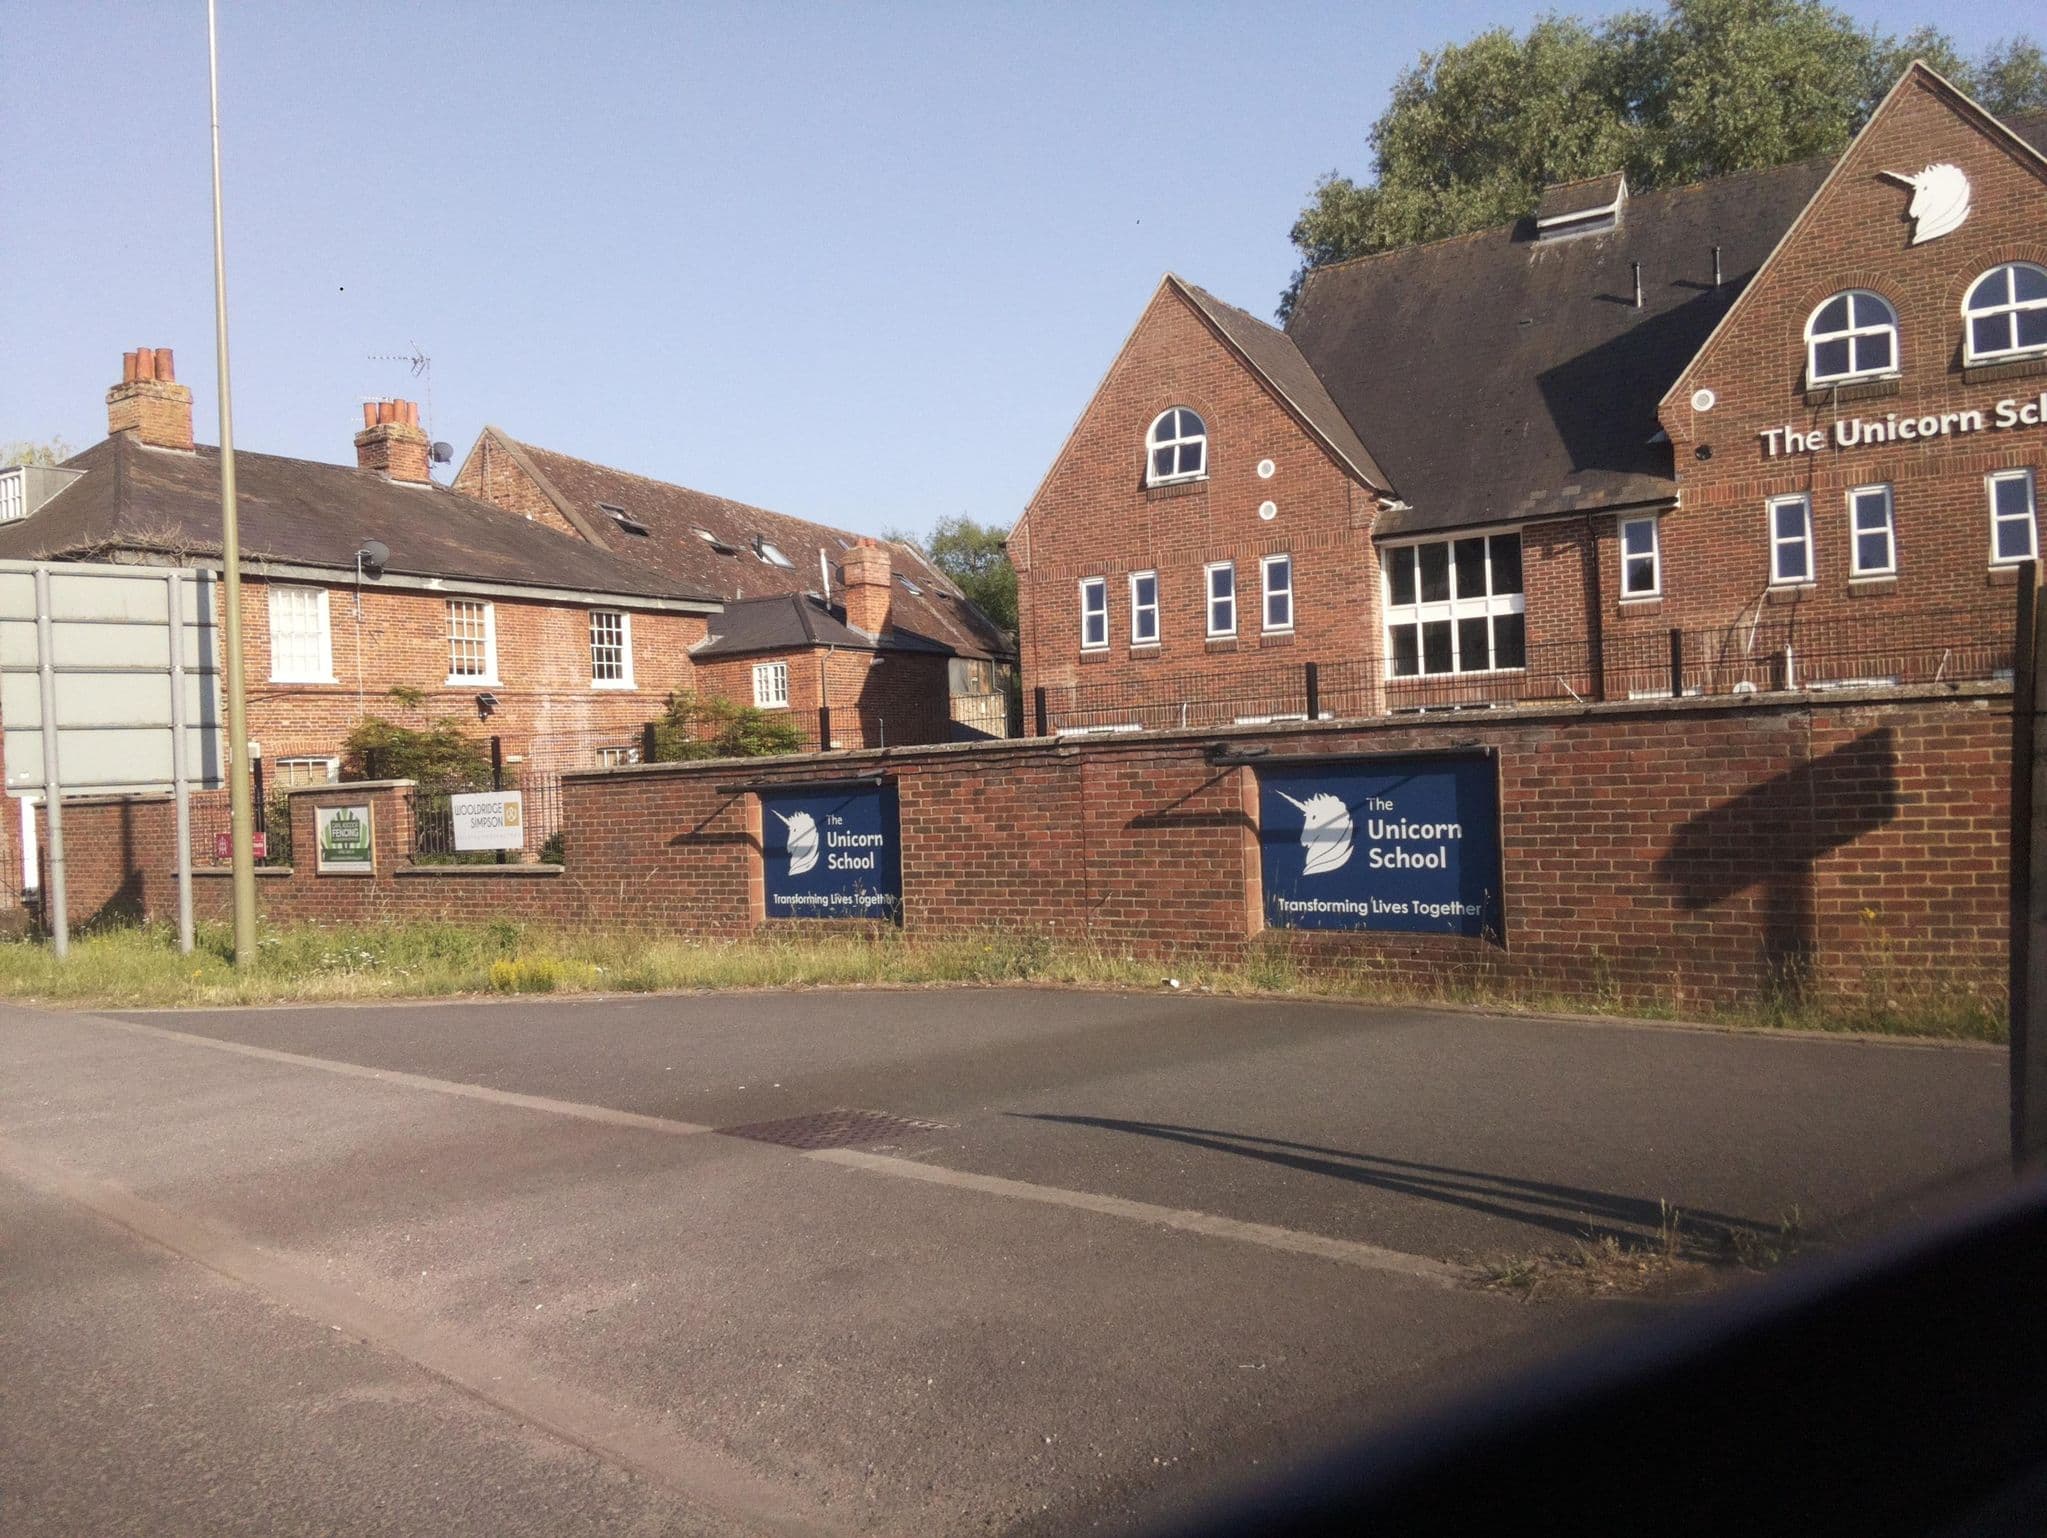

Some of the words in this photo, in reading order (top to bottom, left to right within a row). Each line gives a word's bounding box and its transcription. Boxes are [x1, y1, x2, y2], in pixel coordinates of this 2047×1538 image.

[1760, 425, 1825, 456] The
[1836, 409, 1981, 446] Unicorn
[1365, 797, 1394, 812] The
[471, 816, 503, 828] SIMPSON
[826, 814, 843, 826] The
[1367, 818, 1463, 840] Unicorn
[827, 830, 883, 848] Unicorn
[827, 851, 874, 870] School
[1369, 845, 1446, 869] School
[773, 893, 829, 907] Transforming
[830, 893, 853, 905] Lives
[1278, 898, 1369, 917] Transforming
[1372, 899, 1408, 915] Lives
[1412, 900, 1482, 918] Together
